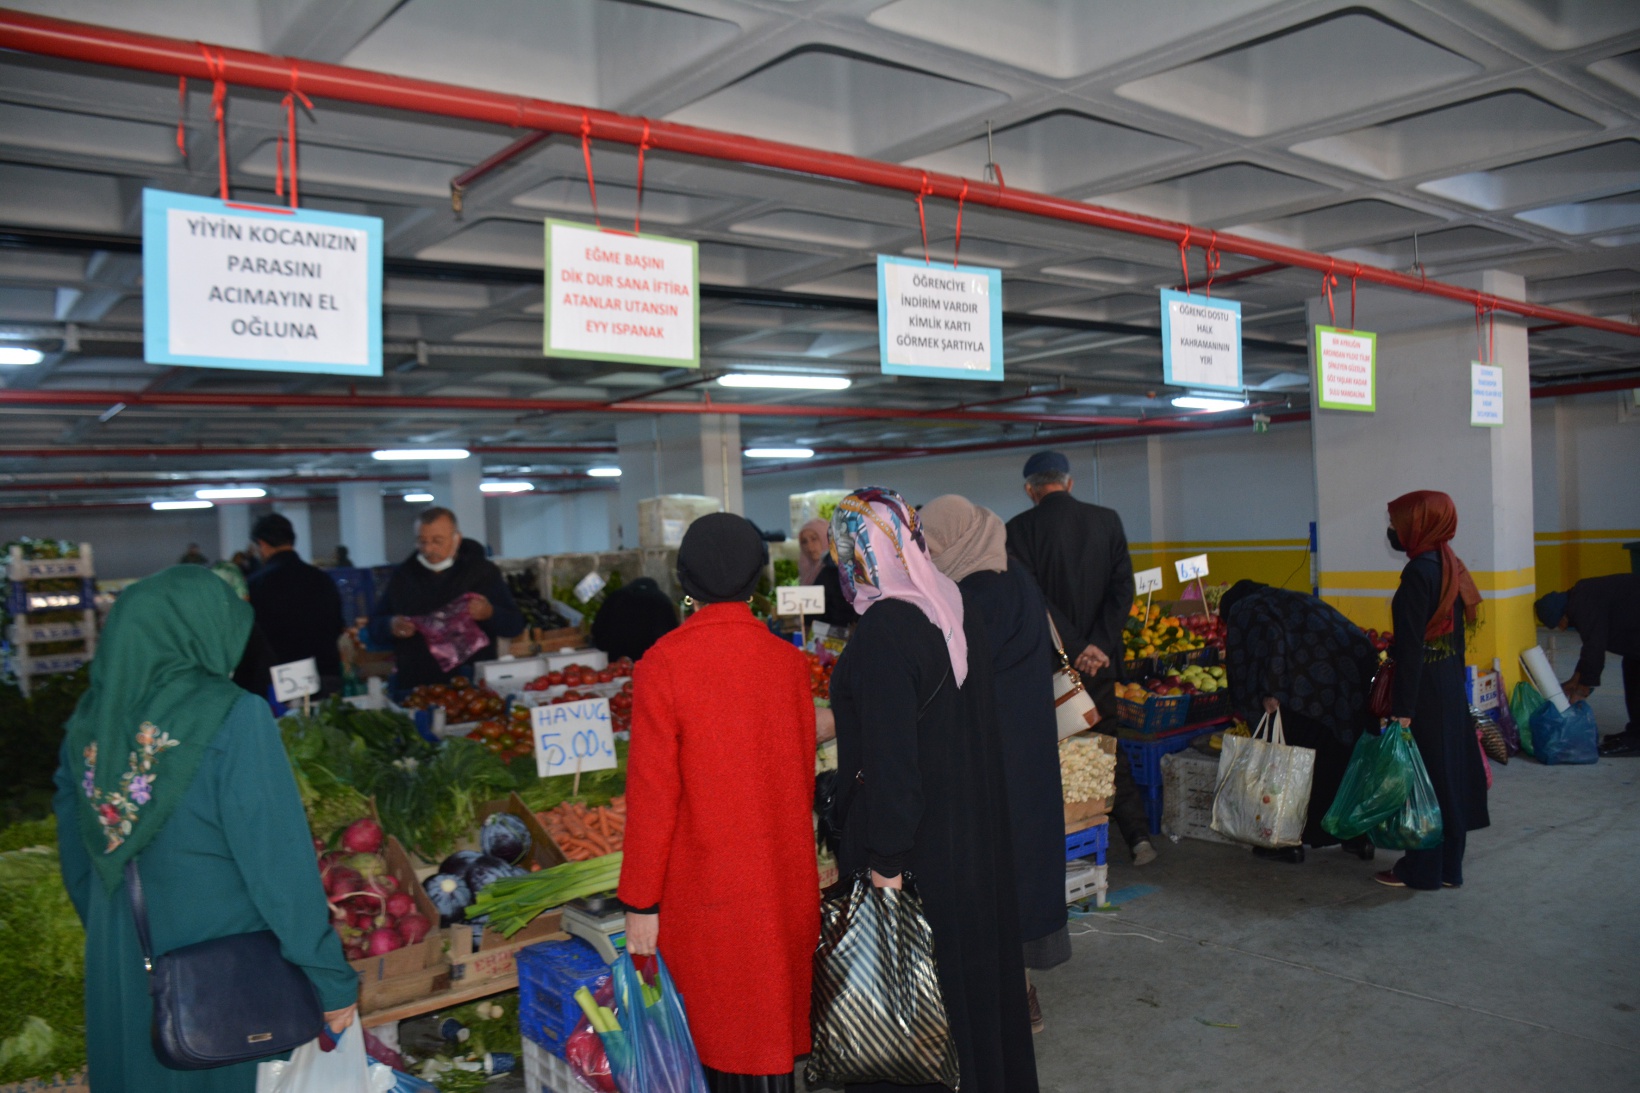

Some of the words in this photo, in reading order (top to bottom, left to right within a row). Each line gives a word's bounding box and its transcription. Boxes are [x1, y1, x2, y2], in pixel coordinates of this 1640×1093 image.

[187, 216, 242, 241] YİYİN
[249, 226, 357, 252] KOCANIZIN
[227, 255, 322, 279] PARASINI
[585, 246, 620, 265] EĞME
[625, 253, 665, 271] BAŞINI
[561, 268, 583, 284] DİK
[587, 273, 613, 288] DUR
[616, 276, 650, 292] SANA
[653, 278, 689, 297] İFTİRA
[913, 273, 966, 293] ÖĞRENCİYE
[208, 285, 313, 310] ACIMAYIN
[318, 294, 339, 311] EL
[563, 292, 621, 311] ATANLAR
[625, 300, 678, 317] UTANSIN
[901, 295, 940, 310] İNDİRİM
[943, 301, 978, 314] VARDIR
[909, 315, 942, 330] KİMLİK
[945, 320, 971, 333] KARTI
[1208, 310, 1229, 322] DOSTU
[231, 316, 319, 340] OĞLUNA
[586, 320, 608, 333] EYY
[611, 322, 664, 339] ISPANAK
[1197, 324, 1213, 335] HALK
[896, 333, 939, 349] GÖRMEK
[941, 338, 985, 353] ŞARTIYLA
[801, 597, 822, 609] TL
